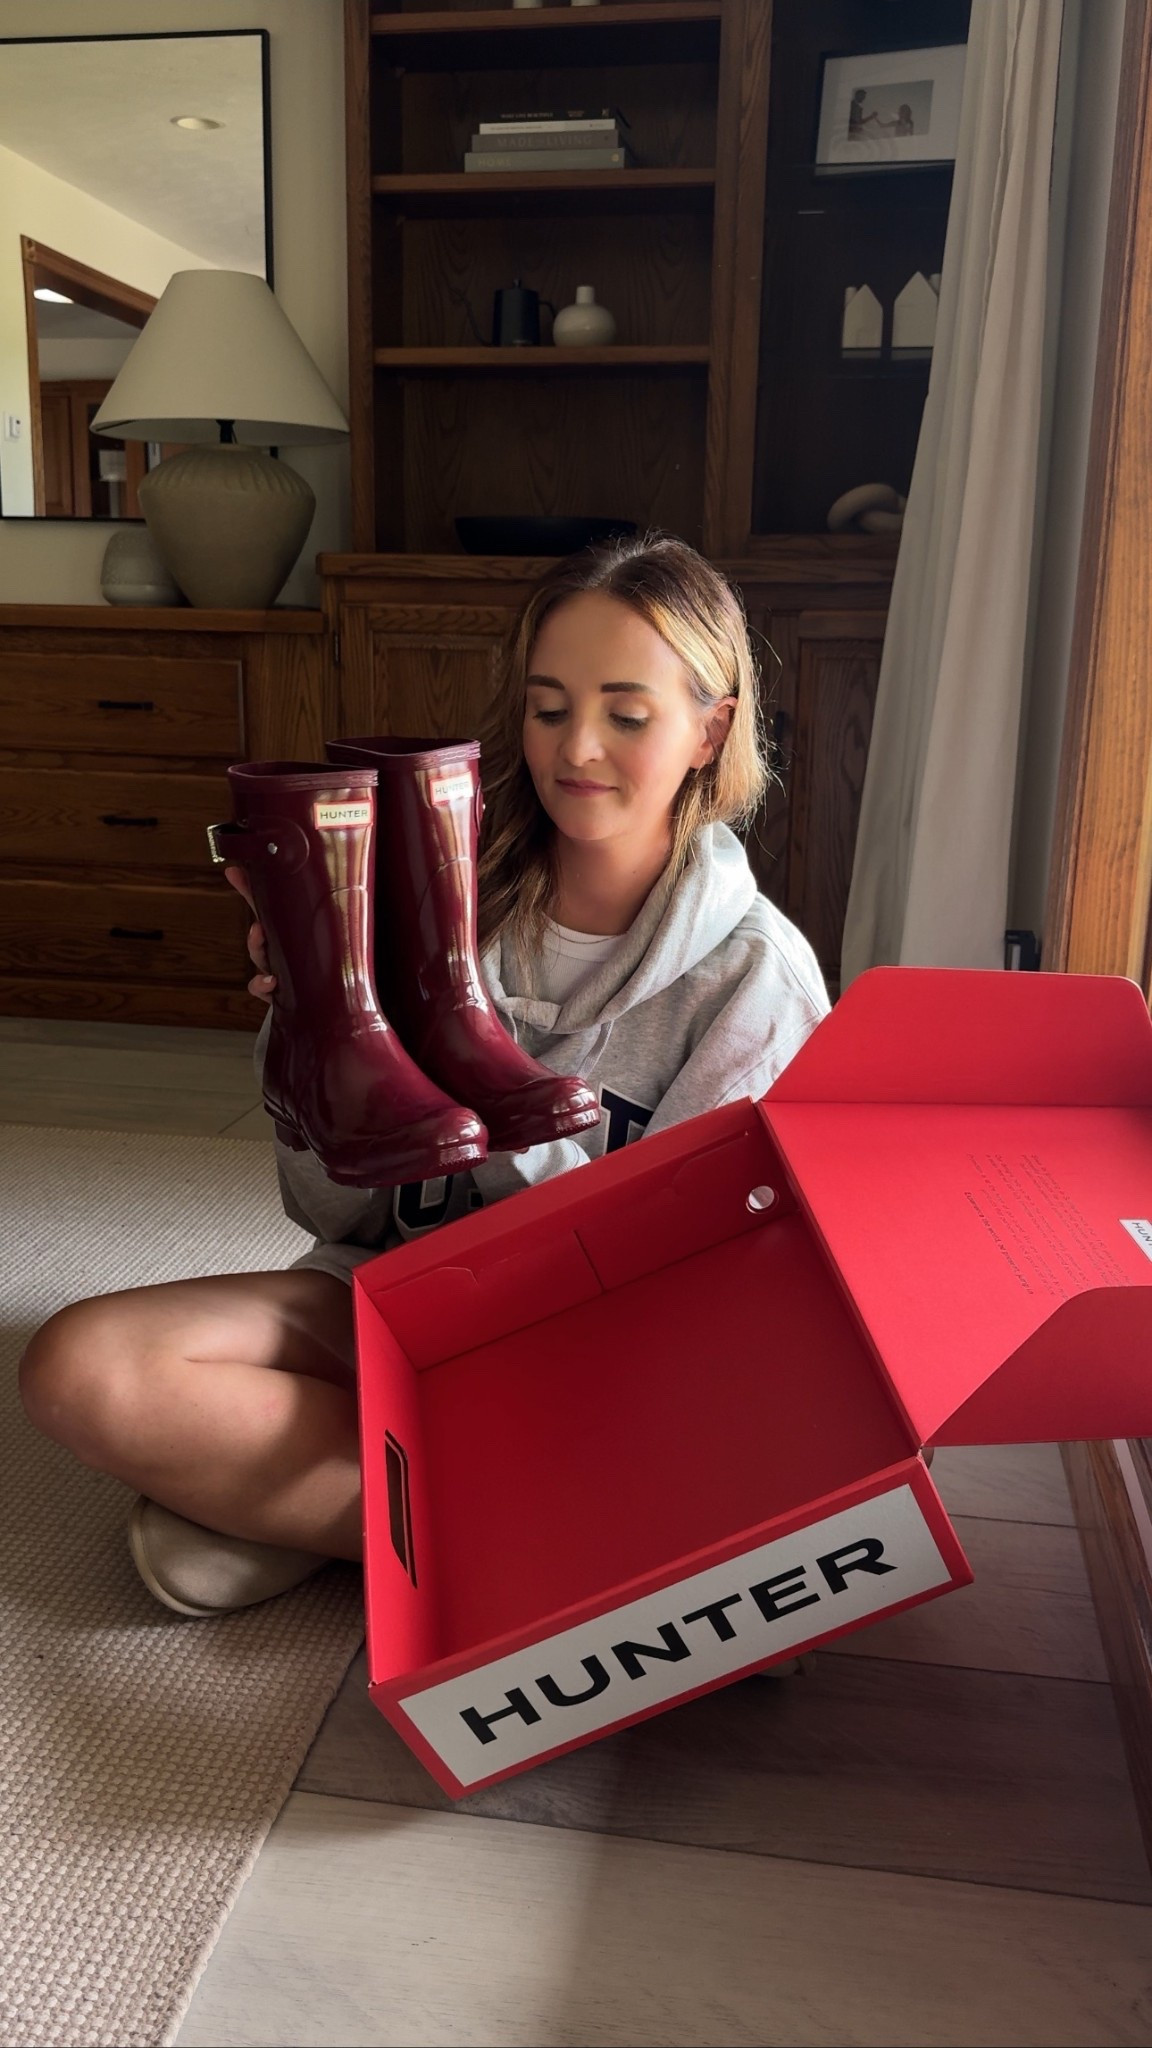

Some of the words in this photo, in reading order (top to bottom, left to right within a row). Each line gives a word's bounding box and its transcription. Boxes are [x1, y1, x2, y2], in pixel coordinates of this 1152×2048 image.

[546, 134, 593, 146] LIVING
[477, 157, 512, 167] HOME
[319, 809, 369, 820] HUNTER
[1132, 1222, 1152, 1246] HUN
[458, 1537, 899, 1746] HUNTER
